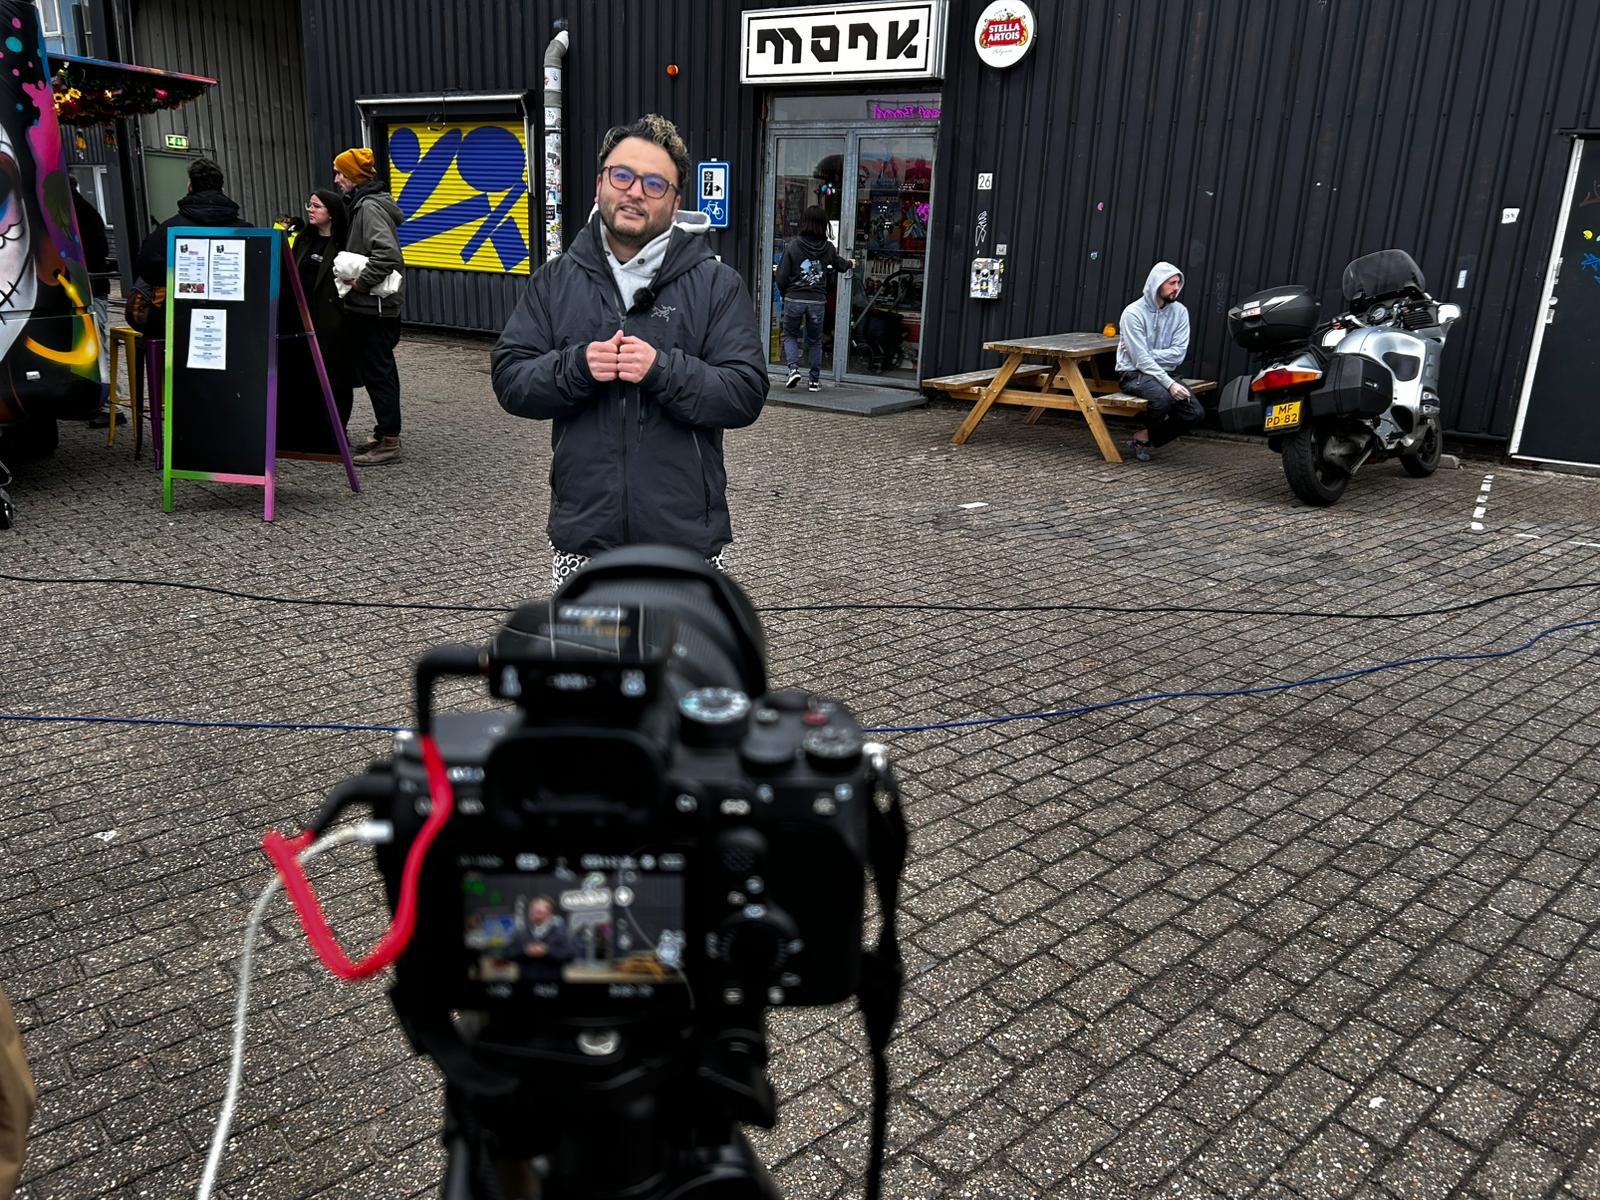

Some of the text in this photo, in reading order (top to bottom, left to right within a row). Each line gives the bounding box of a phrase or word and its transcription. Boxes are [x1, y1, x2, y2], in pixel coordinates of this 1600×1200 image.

[989, 23, 1020, 33] STELLA
[988, 31, 1020, 42] ARTOIS
[979, 175, 991, 188] 26
[1278, 403, 1293, 415] MF
